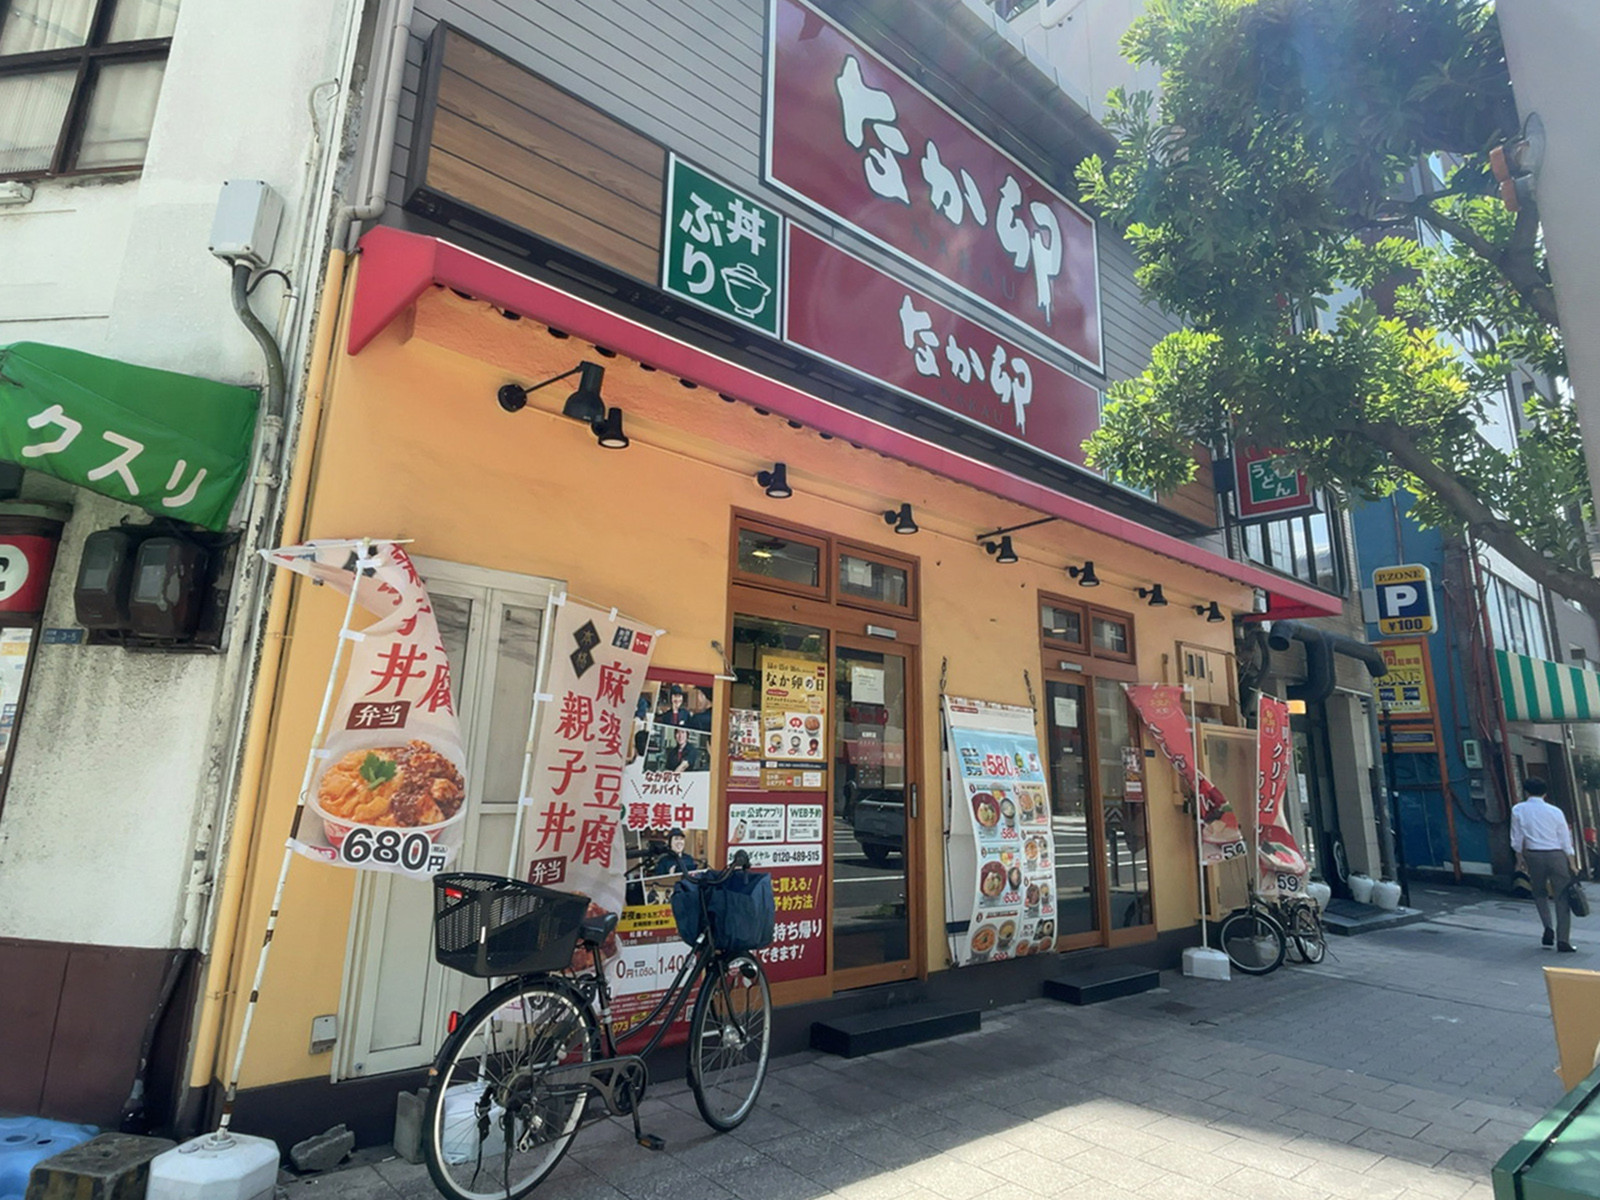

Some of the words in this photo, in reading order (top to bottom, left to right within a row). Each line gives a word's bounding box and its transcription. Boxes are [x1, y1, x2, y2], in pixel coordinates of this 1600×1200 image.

[835, 54, 1063, 325] なか卯
[899, 293, 1033, 436] なか卯
[21, 404, 208, 508] クスリ
[1251, 463, 1291, 497] うどん
[1377, 569, 1422, 583] P.ZONE
[1384, 585, 1418, 617] P
[354, 704, 402, 728] 弁当
[537, 689, 596, 854] 親子丼
[572, 659, 633, 869] 麻婆豆腐
[641, 783, 684, 796] アルバイト
[1263, 741, 1284, 812] クリーム
[627, 801, 695, 830] 募集中
